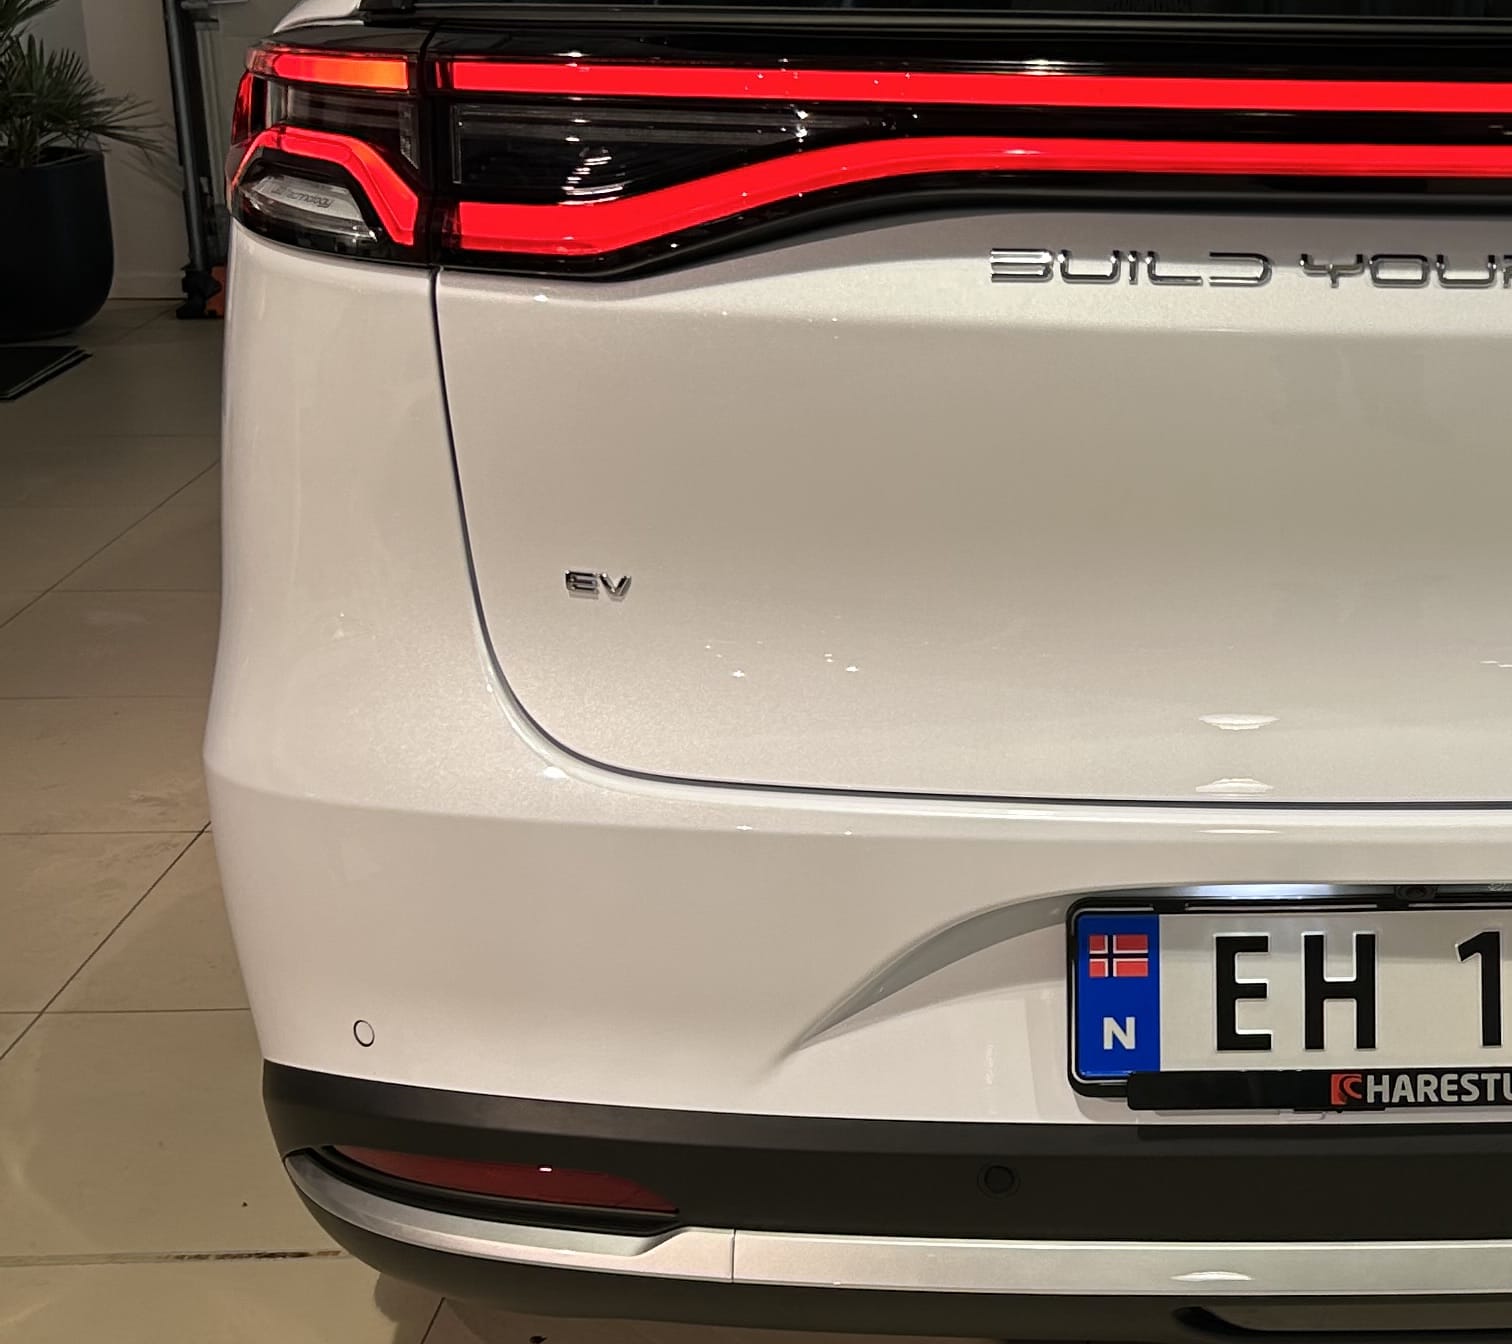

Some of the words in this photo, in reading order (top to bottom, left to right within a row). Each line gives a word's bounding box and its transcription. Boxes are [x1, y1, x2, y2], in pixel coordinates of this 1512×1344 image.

[990, 248, 1273, 287] BUILD
[565, 570, 632, 602] EV
[1215, 932, 1376, 1052] EH
[1103, 1017, 1135, 1050] N
